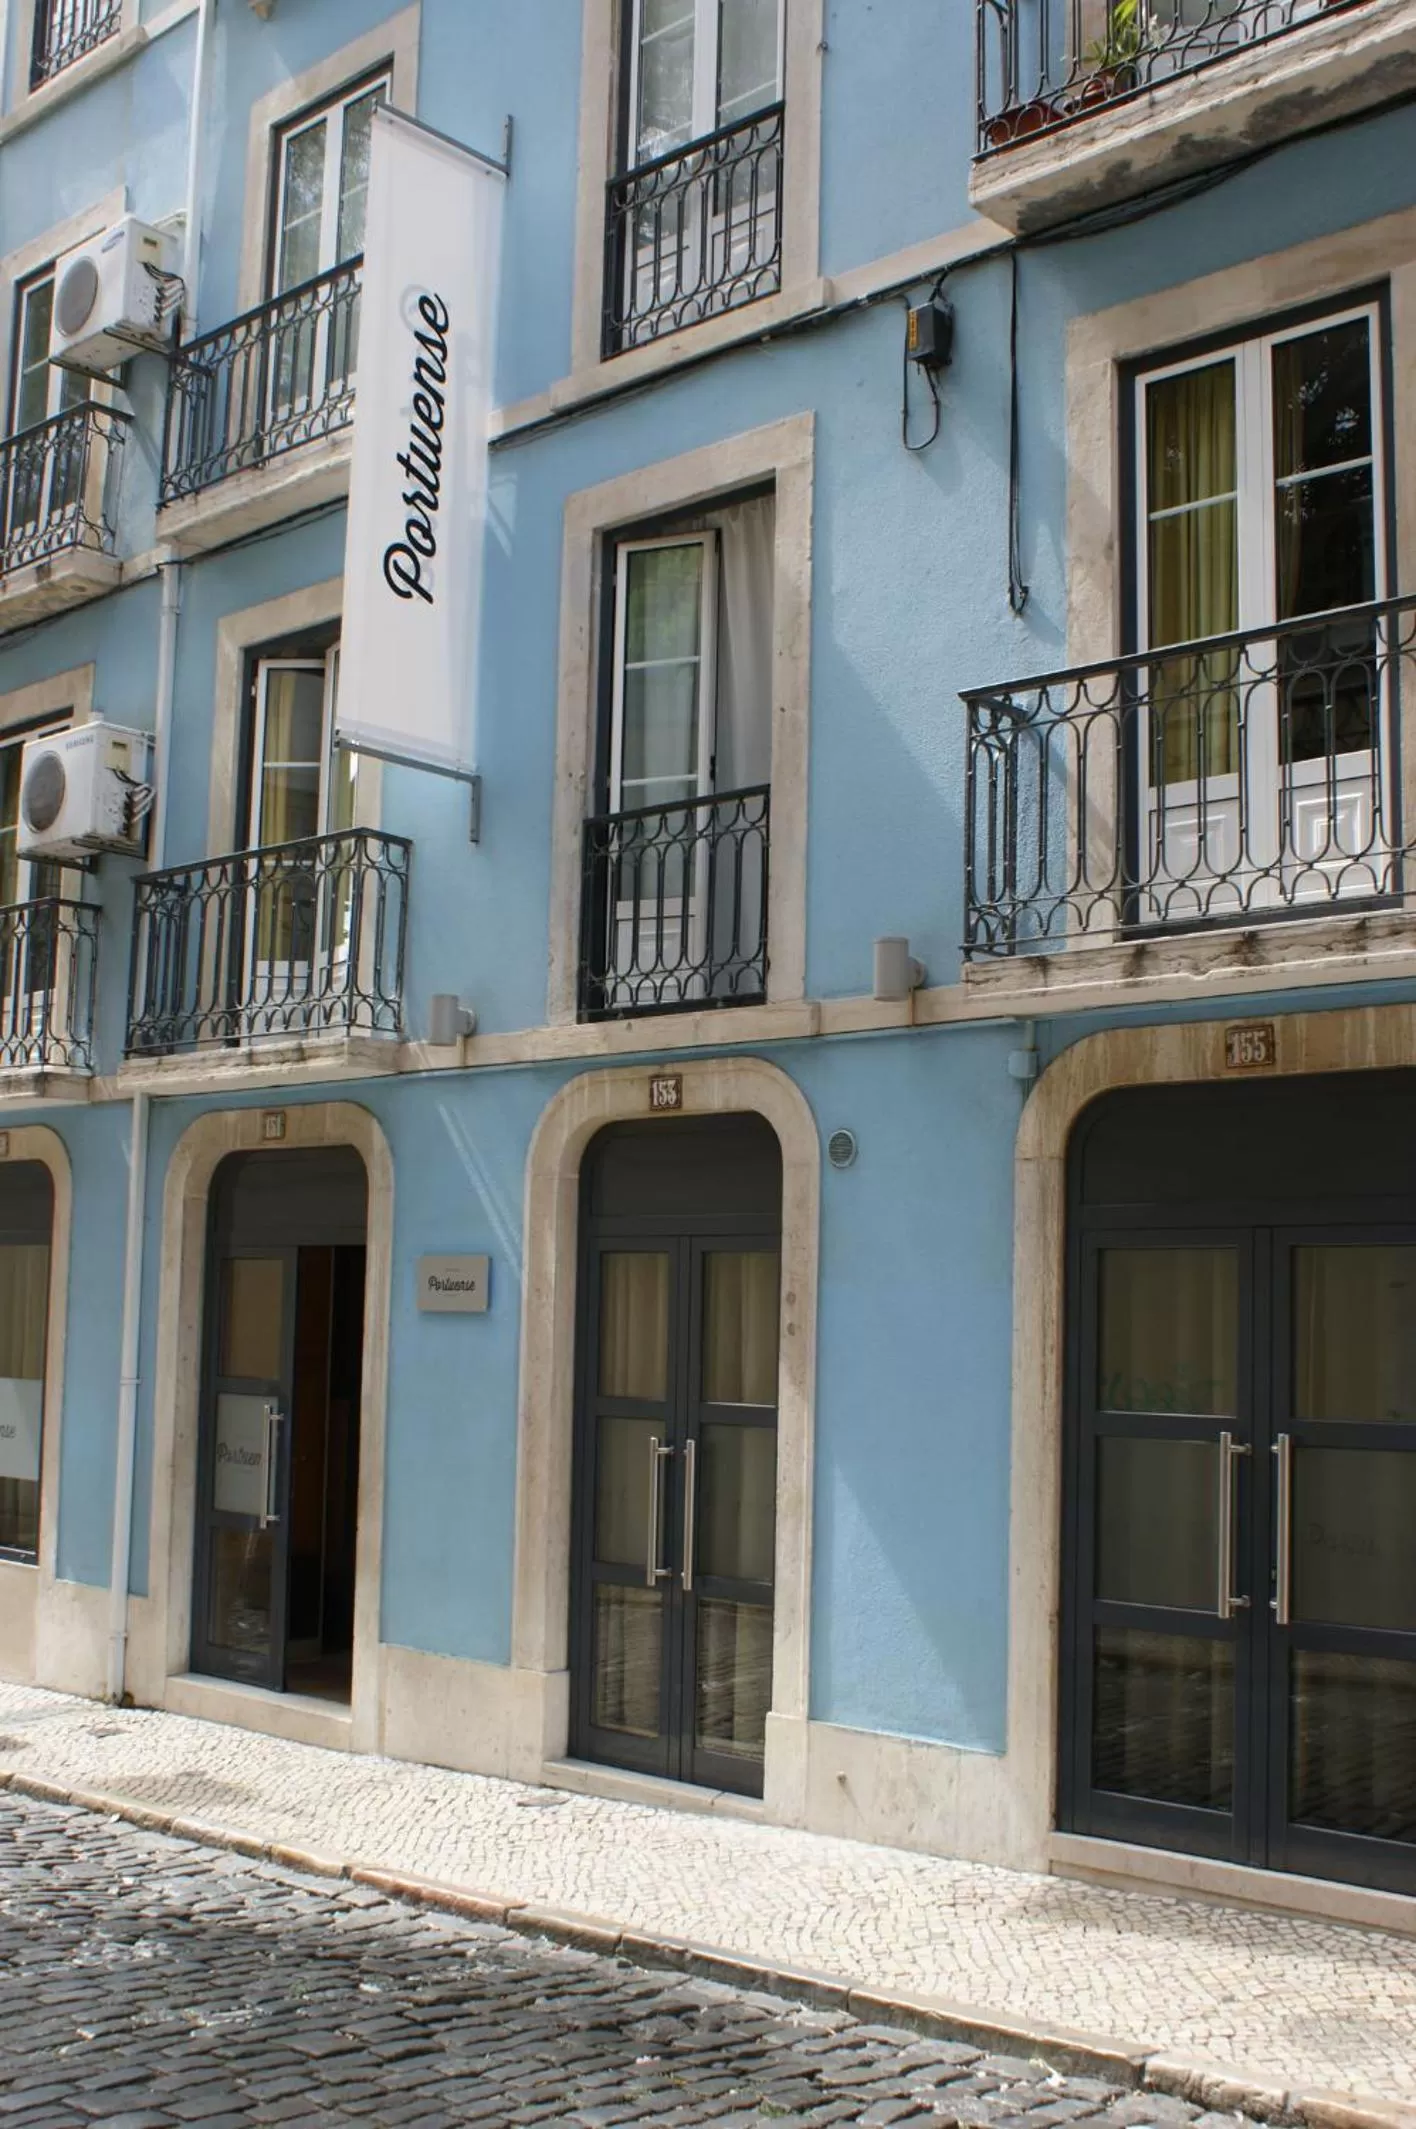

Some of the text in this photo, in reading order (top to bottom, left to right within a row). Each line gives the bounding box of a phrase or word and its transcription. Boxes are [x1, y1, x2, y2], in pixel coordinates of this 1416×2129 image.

[383, 292, 450, 605] Portuense
[1231, 1031, 1266, 1065] 155
[652, 1079, 677, 1106] 153
